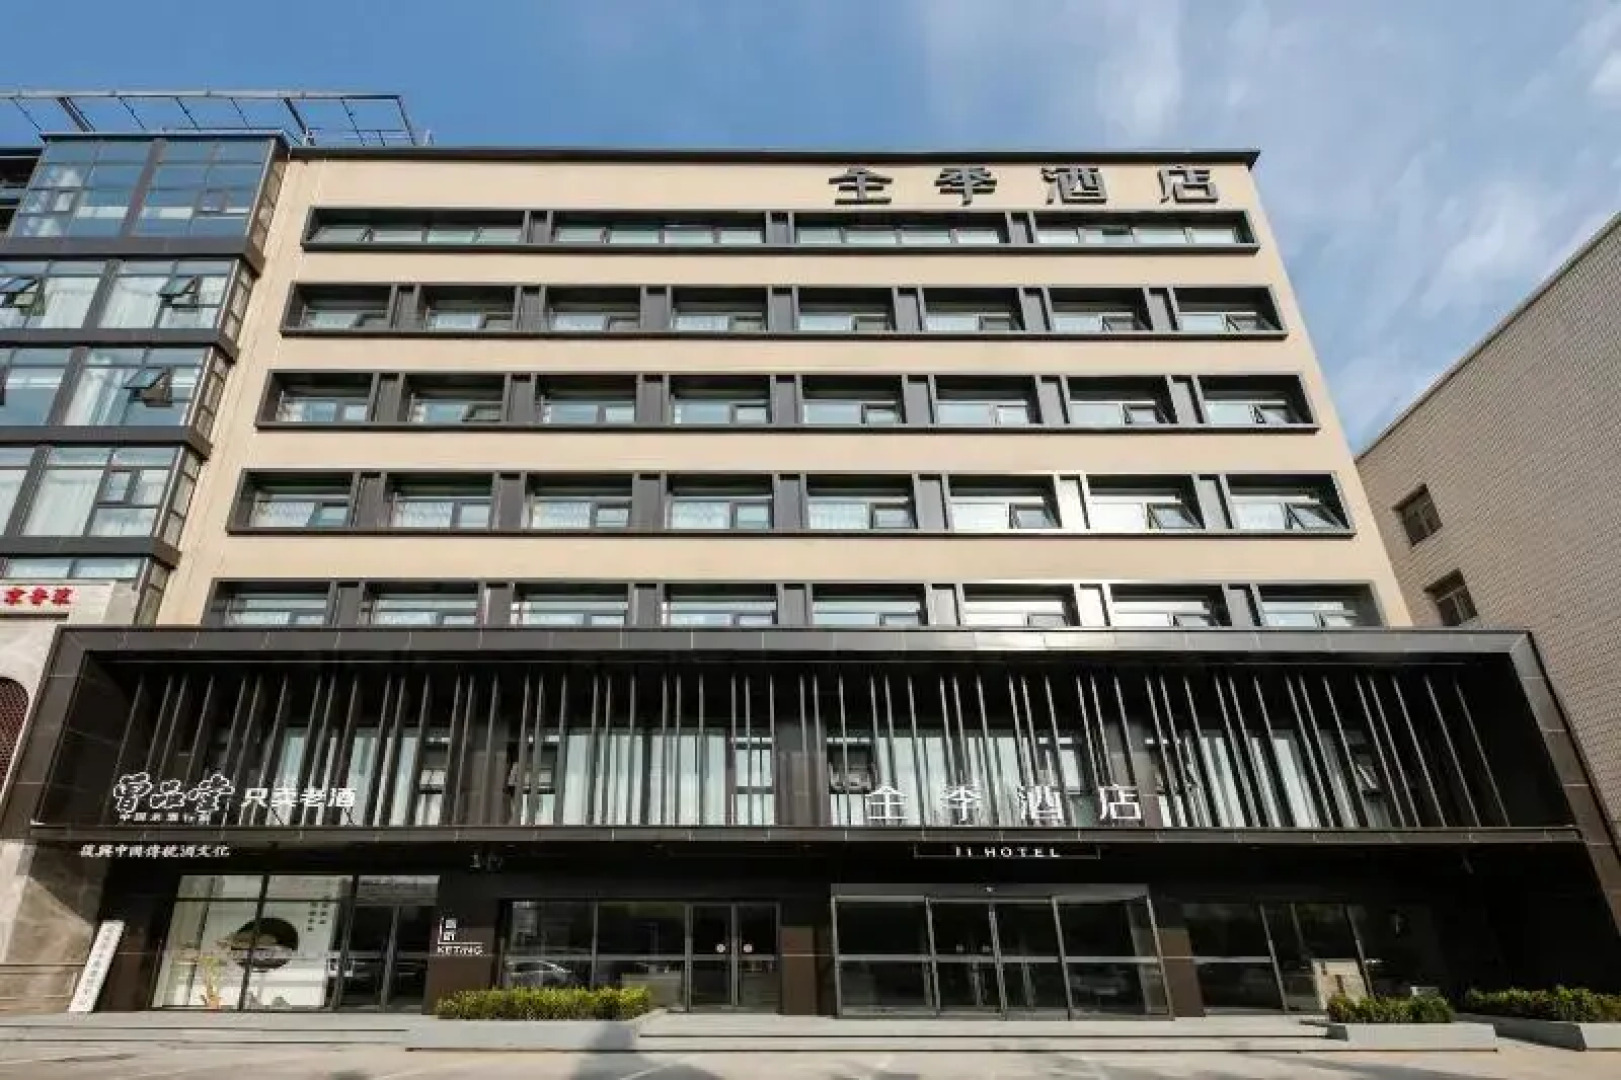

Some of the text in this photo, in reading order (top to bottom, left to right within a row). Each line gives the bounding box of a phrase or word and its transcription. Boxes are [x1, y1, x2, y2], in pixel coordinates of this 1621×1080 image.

[828, 164, 1219, 206] 全季酒店
[865, 783, 1142, 823] 全季酒店
[984, 846, 1061, 858] HOTEL
